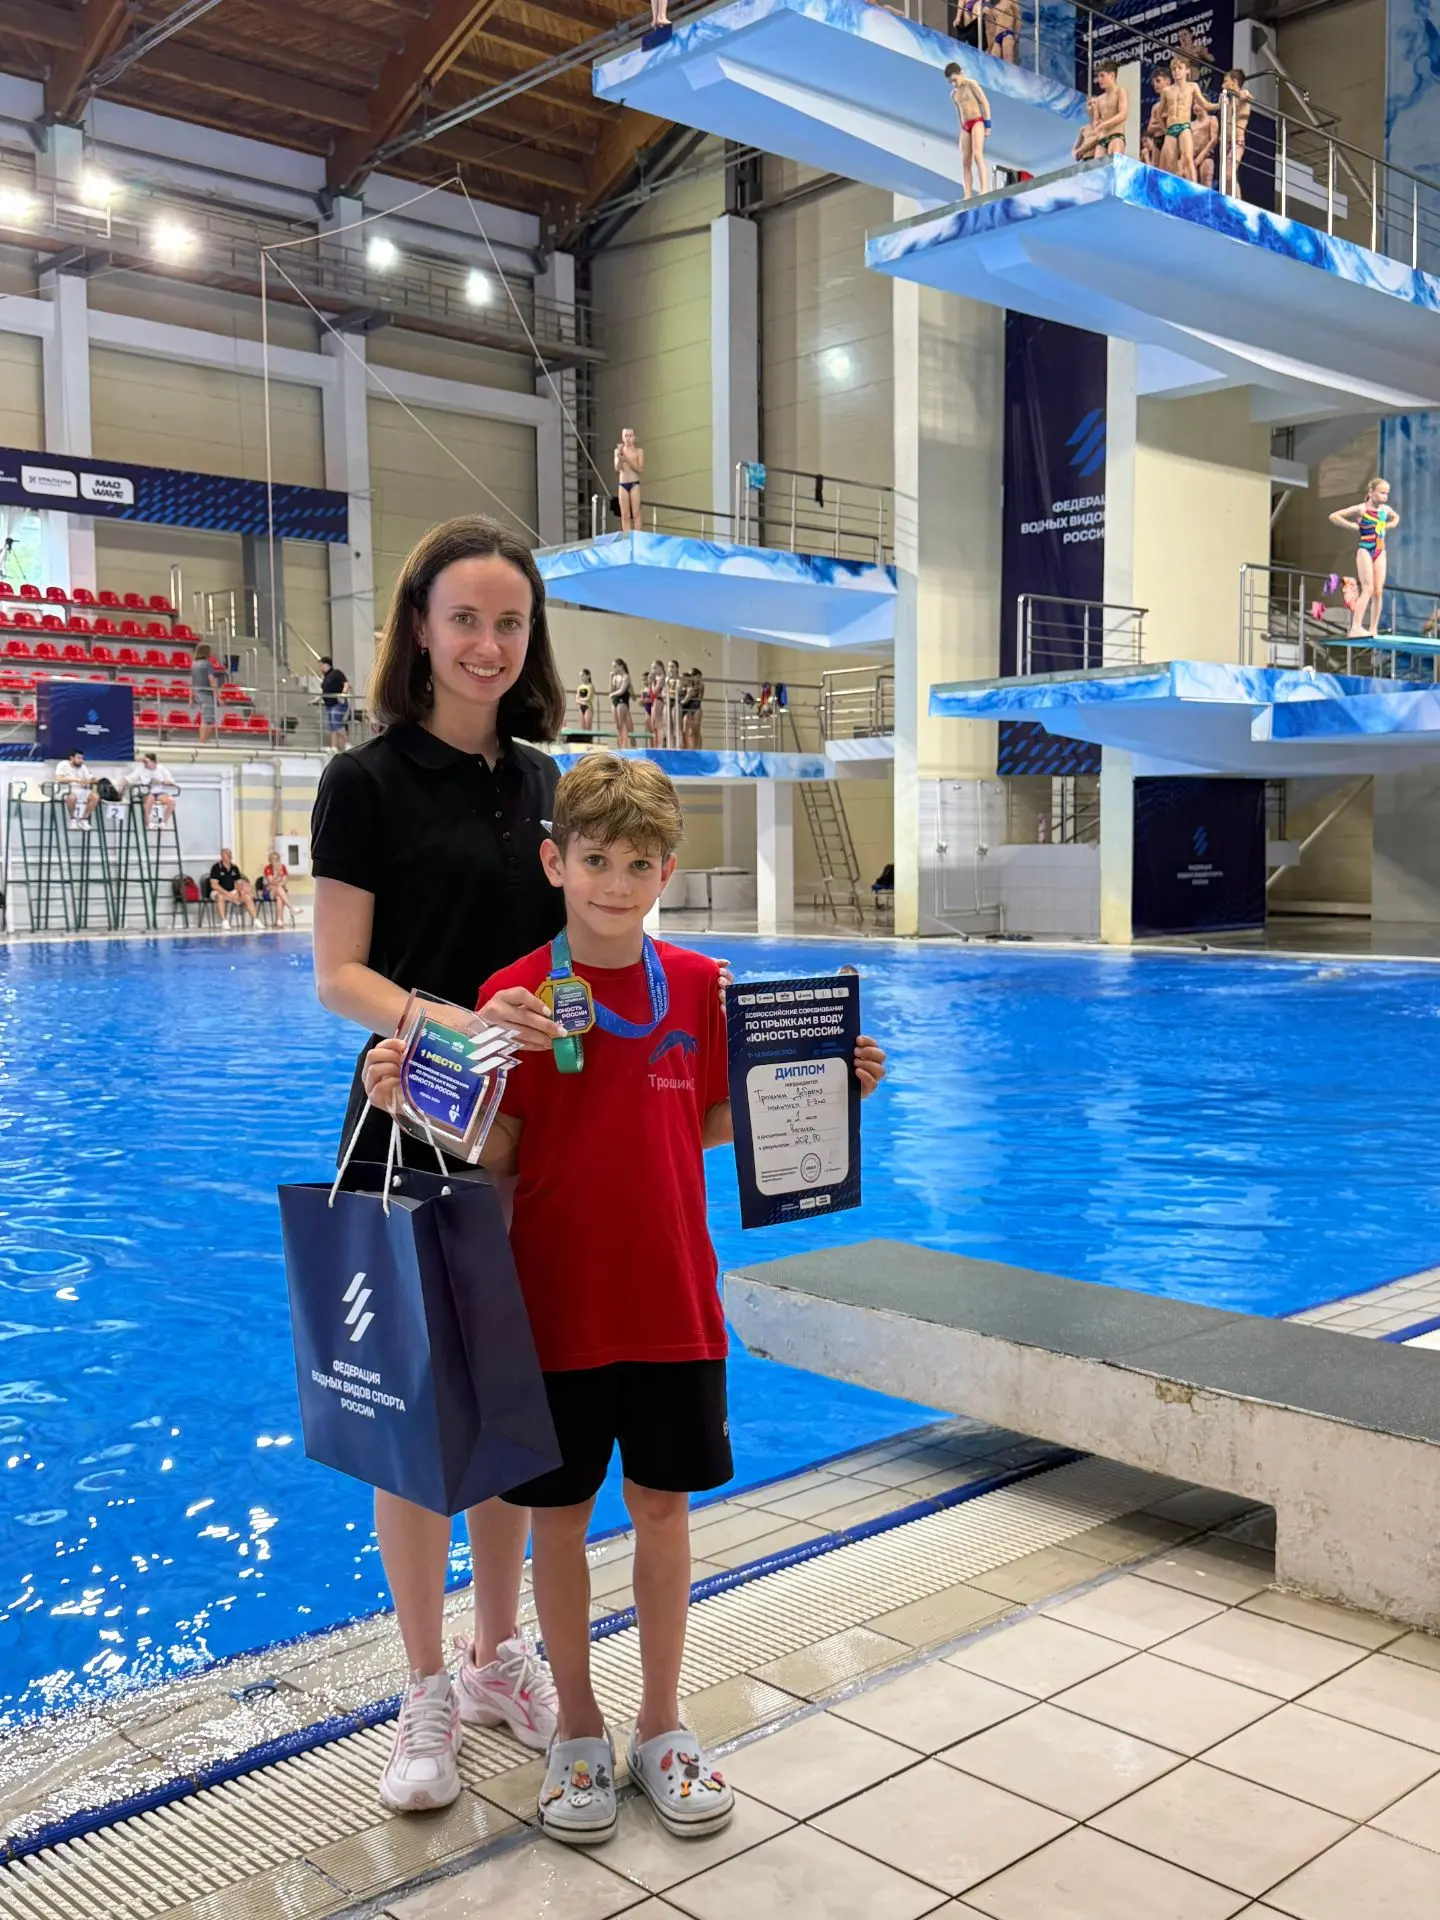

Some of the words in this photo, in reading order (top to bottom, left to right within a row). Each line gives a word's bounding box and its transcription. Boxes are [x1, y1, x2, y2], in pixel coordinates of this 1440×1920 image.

[95, 479, 121, 489] MAD
[92, 488, 124, 499] WAVE
[1069, 511, 1105, 527] ВИДО
[745, 1008, 798, 1019] ВСЕРОССИЙСКИЕ
[798, 1005, 844, 1015] СОРЕВНОВАНИЯ
[745, 1021, 759, 1030] ПО
[761, 1017, 812, 1029] ПРЫЖКАМ
[813, 1016, 819, 1024] В
[820, 1014, 844, 1023] ВОДУ
[746, 1030, 799, 1043] «ЮНОСТЬ
[800, 1025, 845, 1037] РОССИИ»
[421, 1049, 427, 1057] 1
[426, 1051, 463, 1073] МЕСТО
[775, 1064, 825, 1080] ДИПЛОМ
[332, 1360, 381, 1385] ФЕДЕРАЦИЯ
[311, 1370, 343, 1392] ВОДНЫХ
[343, 1382, 371, 1400] ВИДОВ
[372, 1391, 406, 1412] СПОРТА
[340, 1398, 376, 1419] РОССИИ
